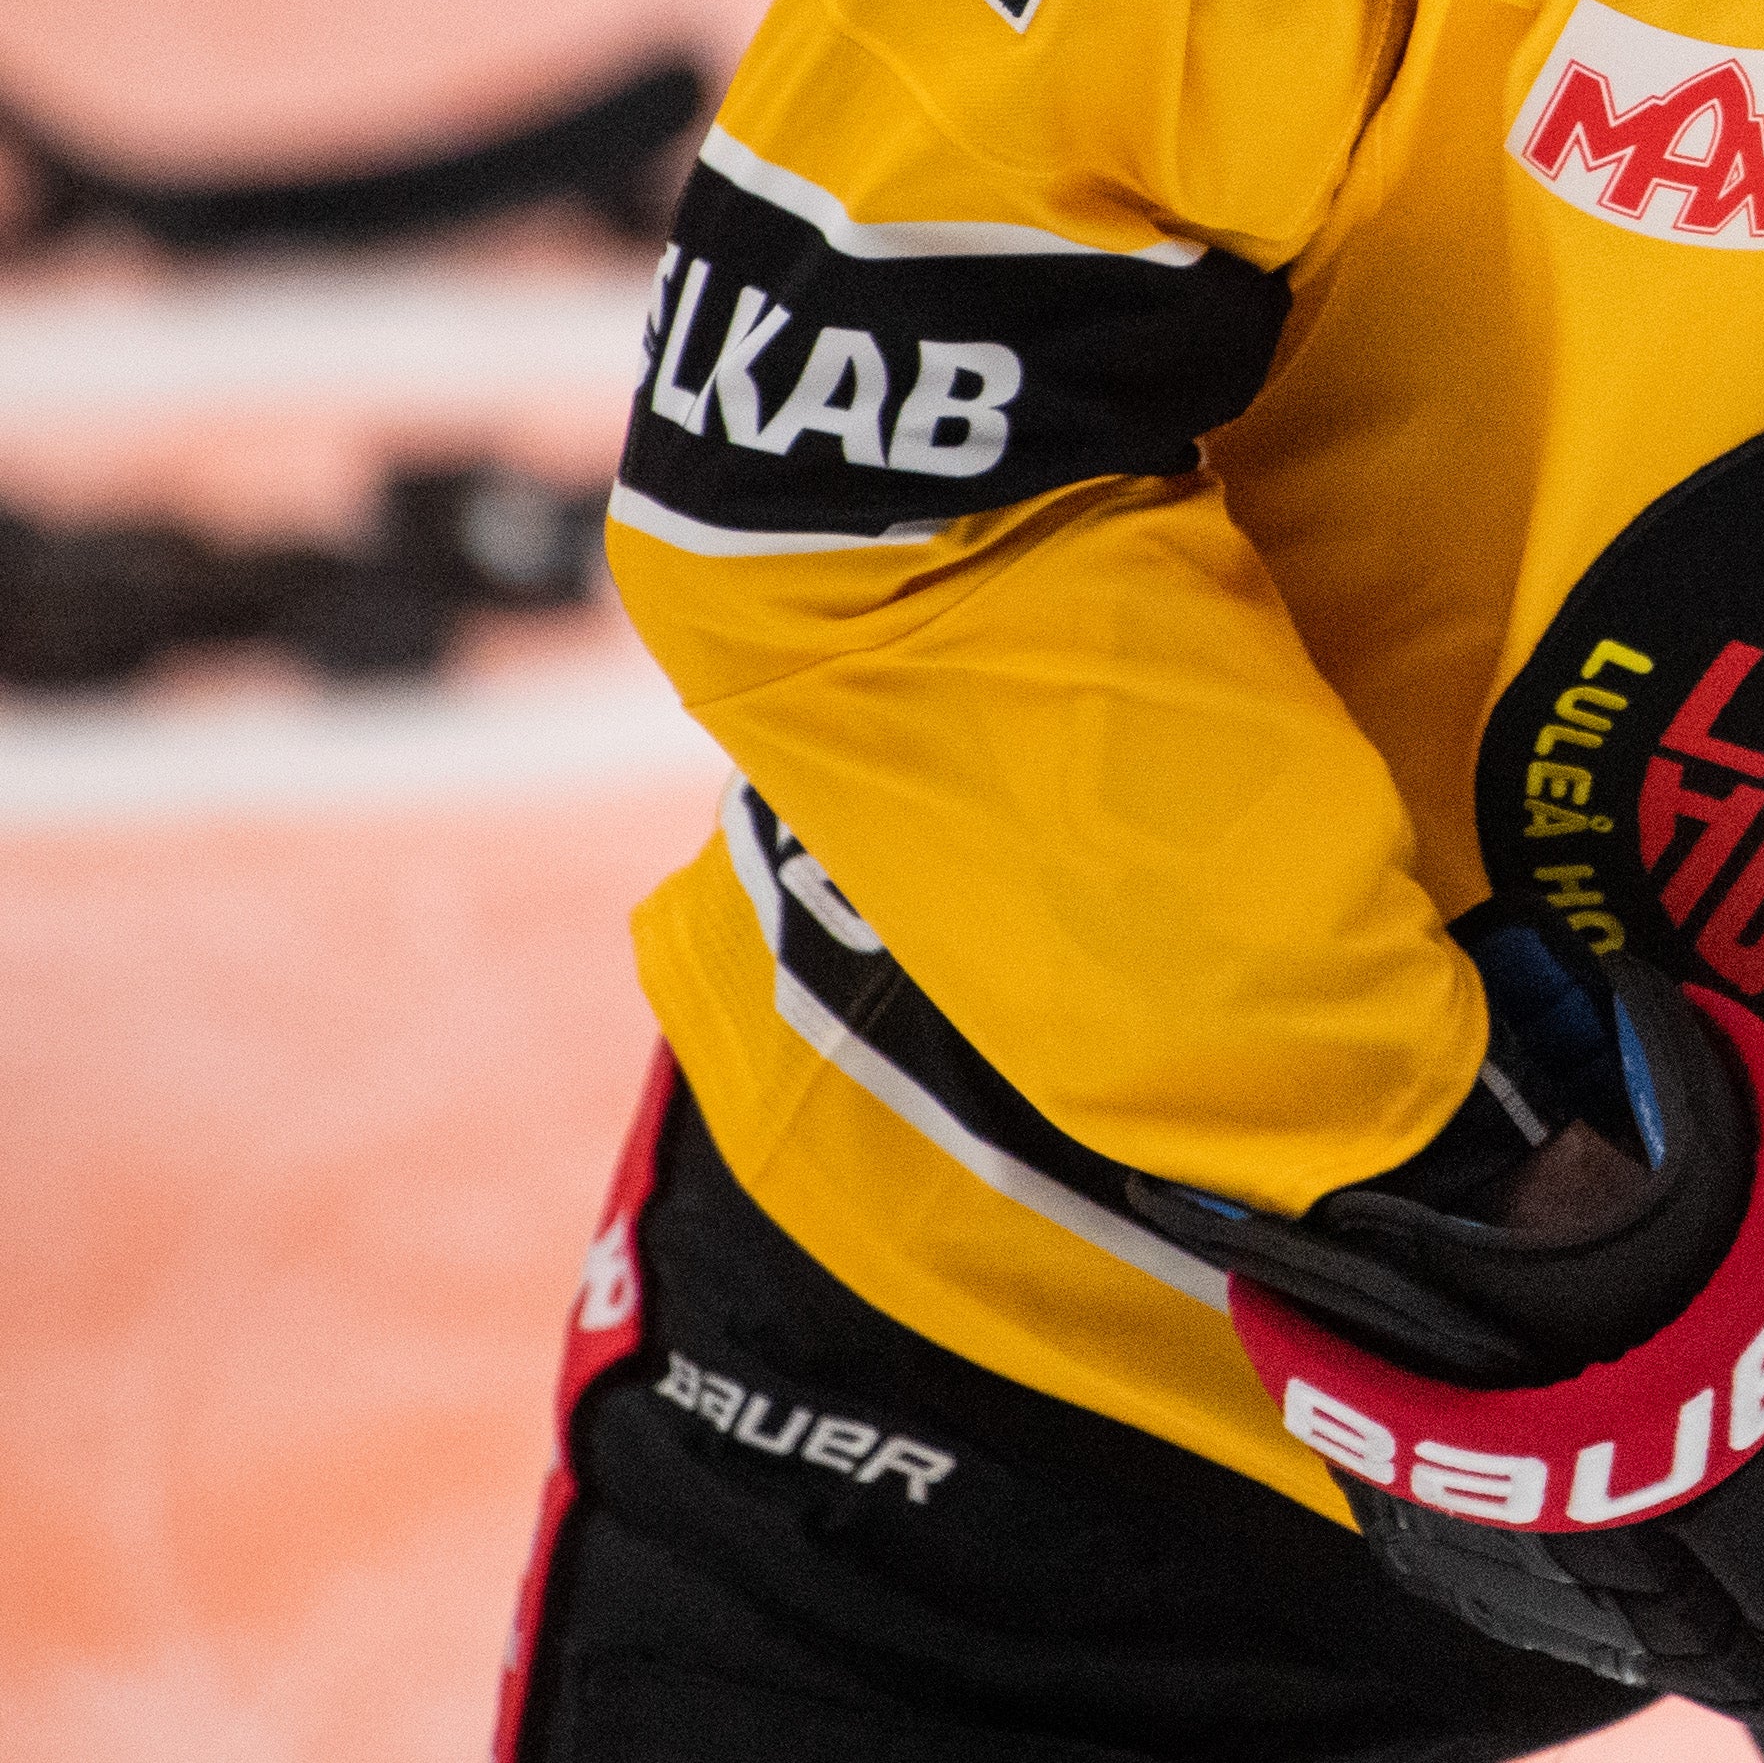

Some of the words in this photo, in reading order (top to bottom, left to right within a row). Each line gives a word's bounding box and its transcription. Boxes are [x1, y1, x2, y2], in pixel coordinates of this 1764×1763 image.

[651, 258, 1022, 478] LKAB
[1522, 638, 1654, 838] LULEÅ
[655, 1350, 957, 1505] BAUER
